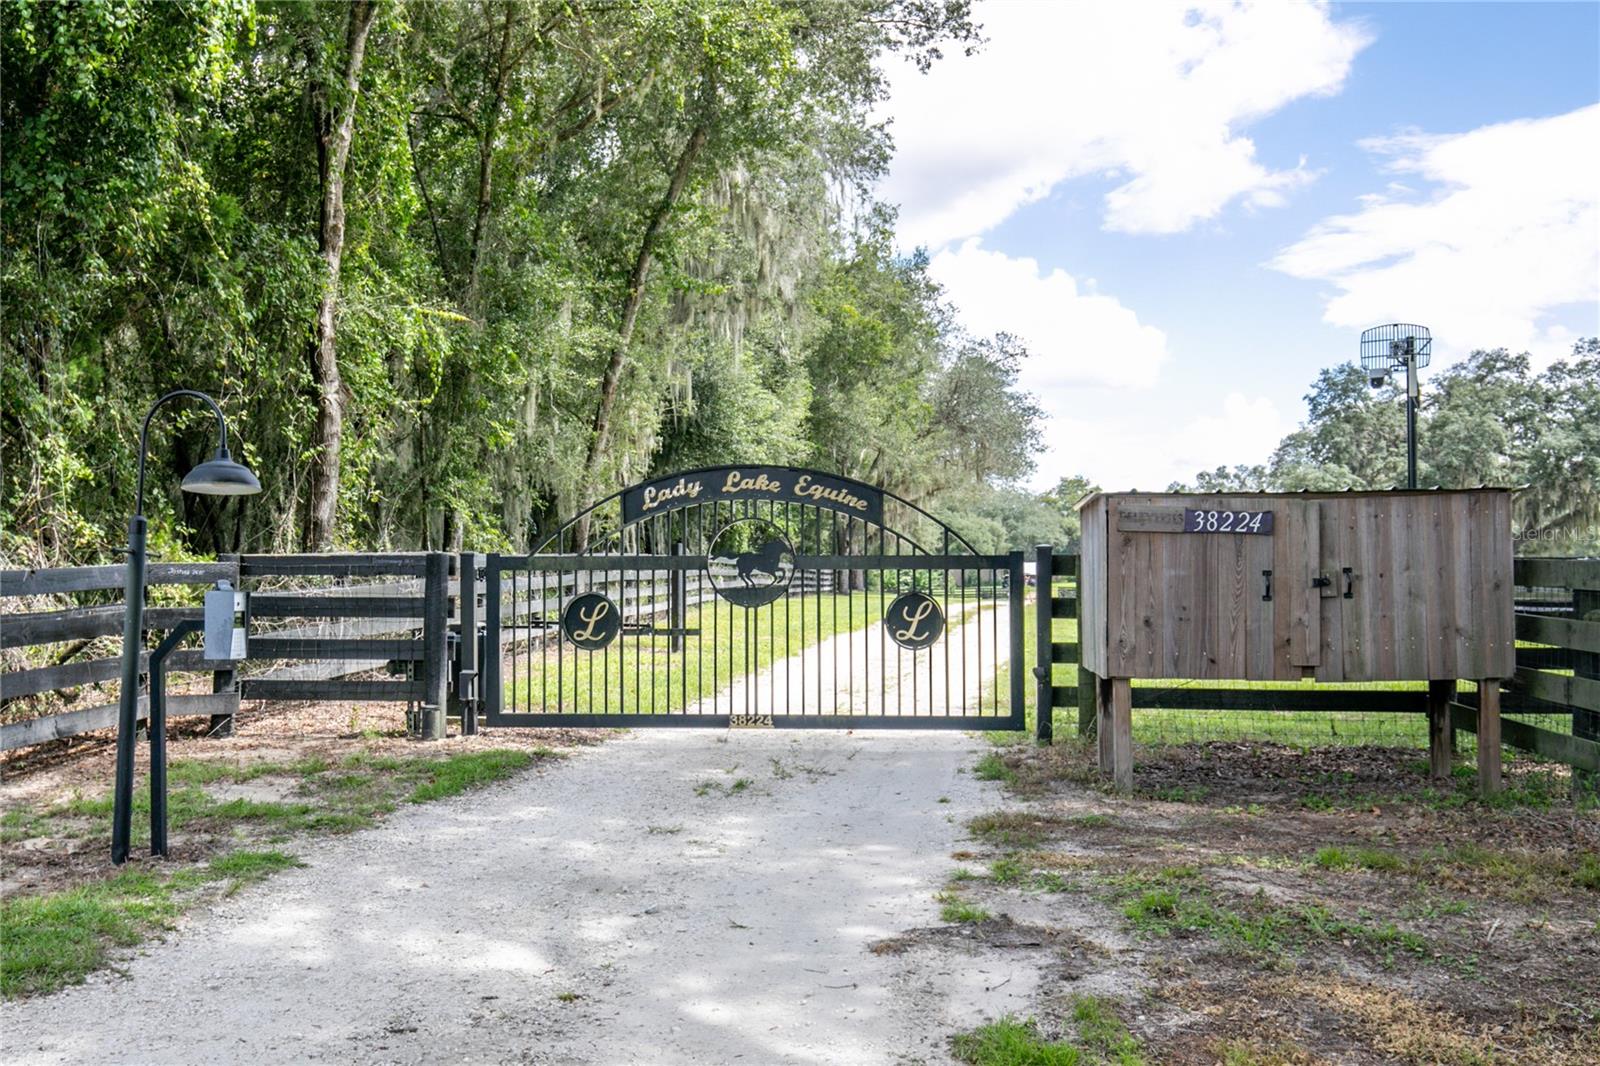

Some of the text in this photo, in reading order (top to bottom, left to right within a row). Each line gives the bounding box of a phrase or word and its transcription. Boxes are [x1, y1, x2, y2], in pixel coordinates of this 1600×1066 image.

[642, 470, 868, 511] Lady Lake Equine
[1193, 510, 1263, 532] 38224
[573, 601, 609, 641] L
[896, 600, 933, 640] L
[730, 714, 773, 727] 38224
